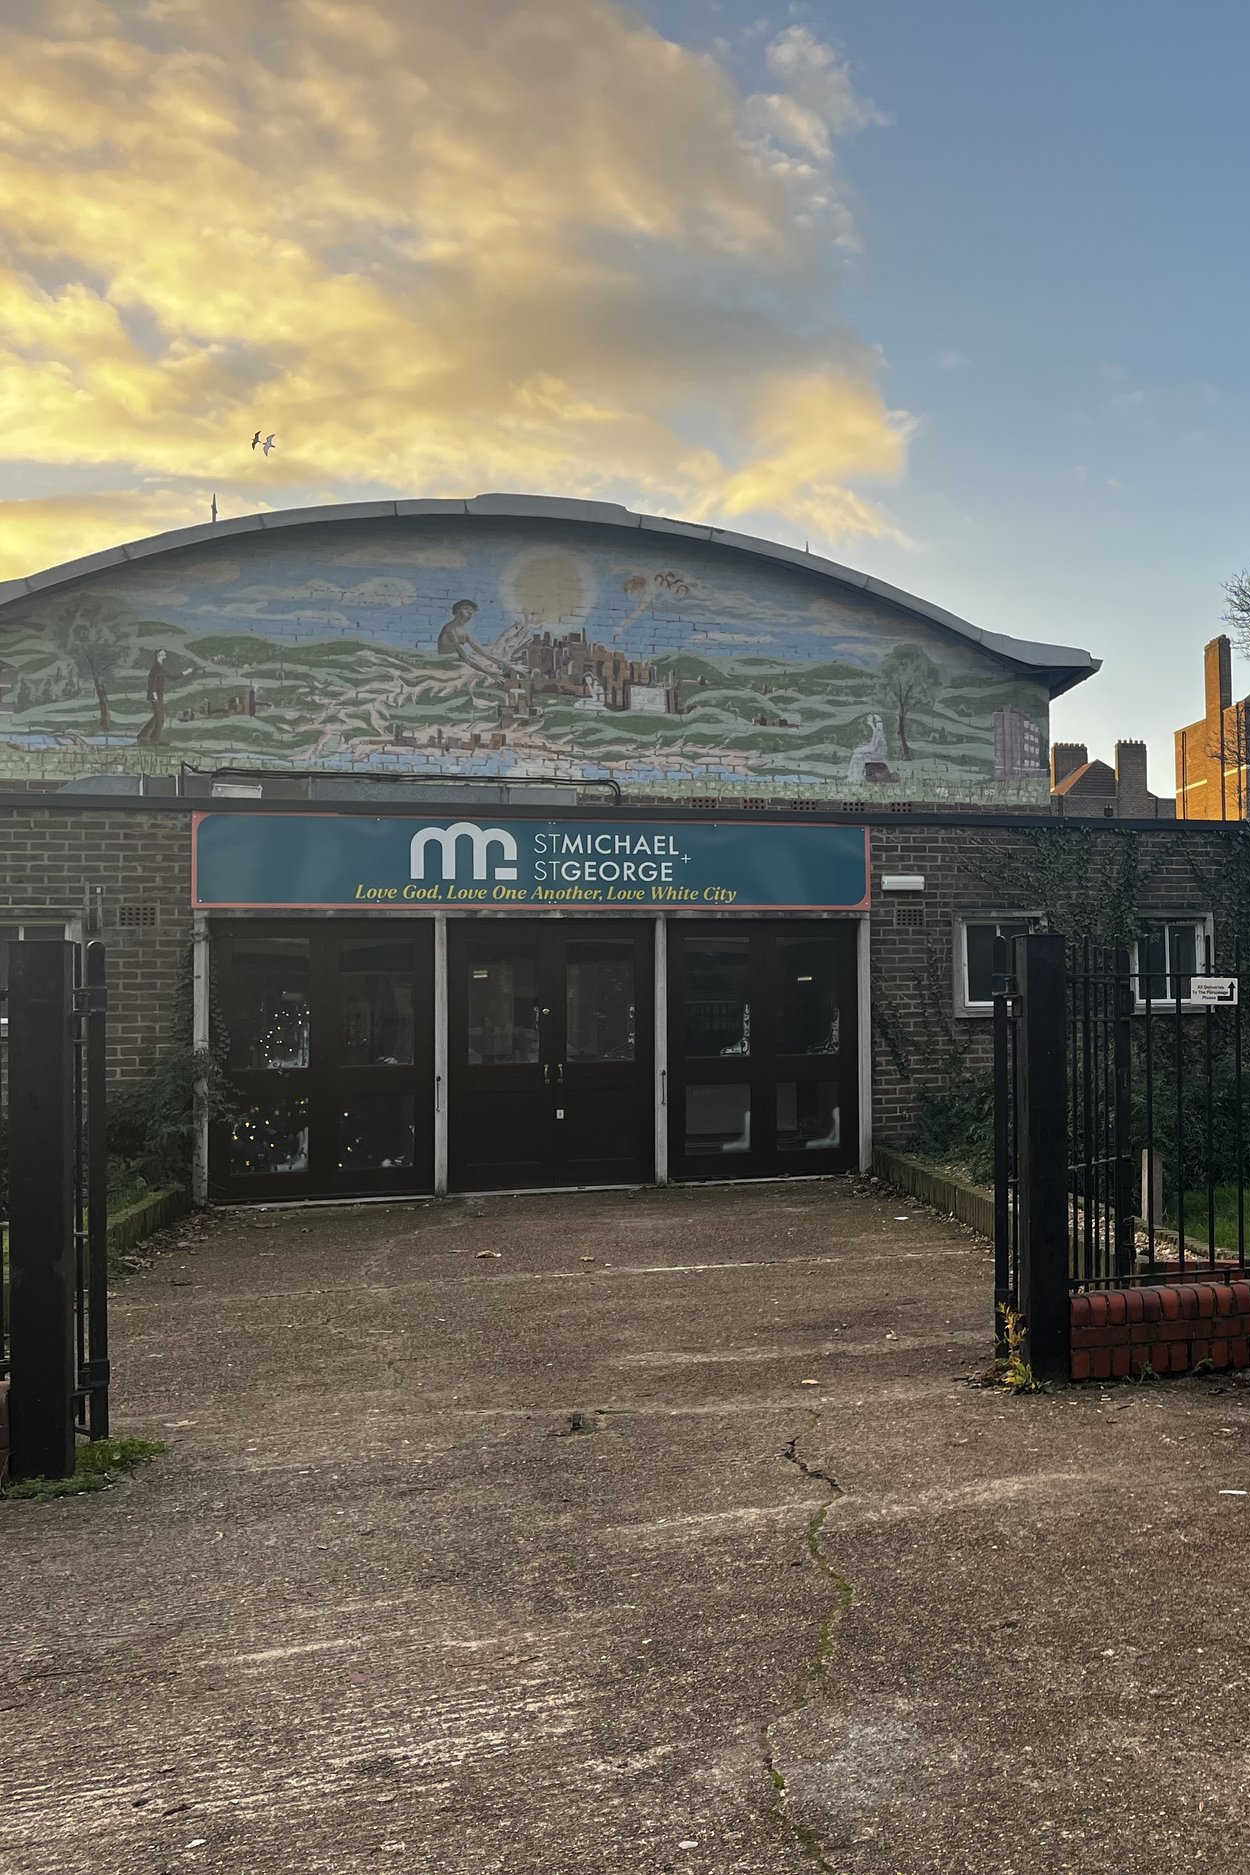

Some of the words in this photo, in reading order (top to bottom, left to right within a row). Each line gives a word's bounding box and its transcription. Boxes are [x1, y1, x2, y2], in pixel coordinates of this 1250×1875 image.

[355, 884, 397, 899] Love
[402, 884, 443, 900] God,
[446, 885, 487, 900] Love
[492, 885, 527, 900] One
[531, 885, 602, 901] Another,
[606, 886, 645, 901] Love
[651, 886, 699, 901] White
[703, 887, 737, 903] City
